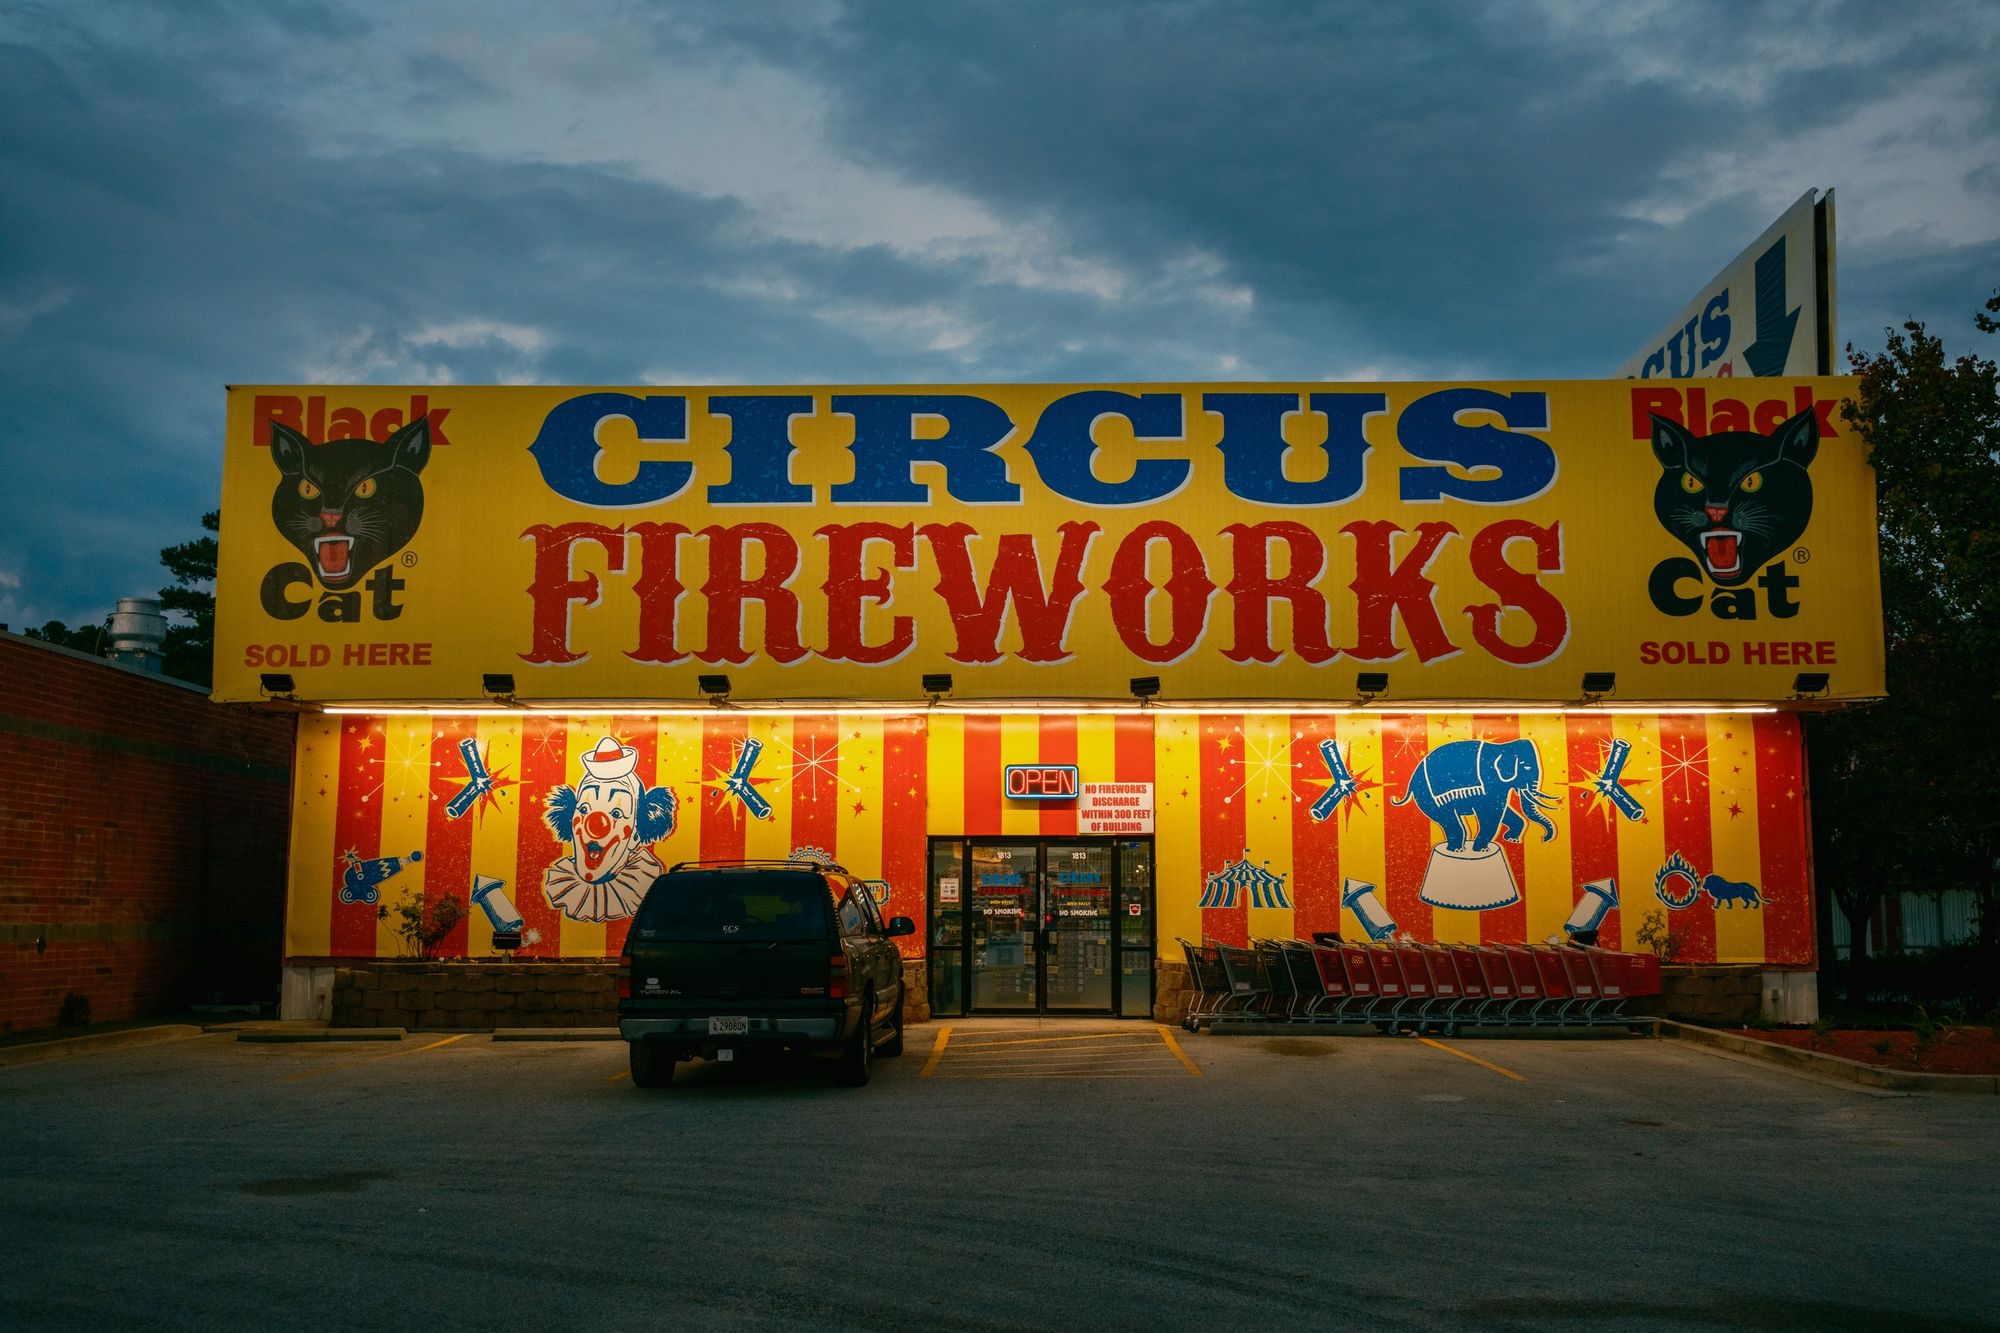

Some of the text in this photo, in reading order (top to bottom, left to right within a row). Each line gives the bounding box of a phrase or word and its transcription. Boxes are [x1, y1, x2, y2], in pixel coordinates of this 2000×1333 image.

[1627, 288, 1731, 378] CUS
[253, 395, 451, 446] Black
[1630, 386, 1840, 440] Black
[526, 388, 1559, 507] CIRCUS
[259, 561, 404, 623] Cat
[517, 519, 1569, 668] FIREWORKS
[1648, 557, 1800, 620] Cat
[244, 643, 432, 667] SOLD HERE
[1640, 641, 1837, 665] SOLD HERE
[1009, 769, 1075, 794] OPEN
[1085, 784, 1147, 794] NO FIREWORKS
[1081, 809, 1151, 819] WITHIN 300 FEET
[1092, 797, 1140, 807] DISCHARGE
[1091, 822, 1142, 832] OF BUILDING
[997, 851, 1012, 859] 1813
[1072, 852, 1087, 860] 1813
